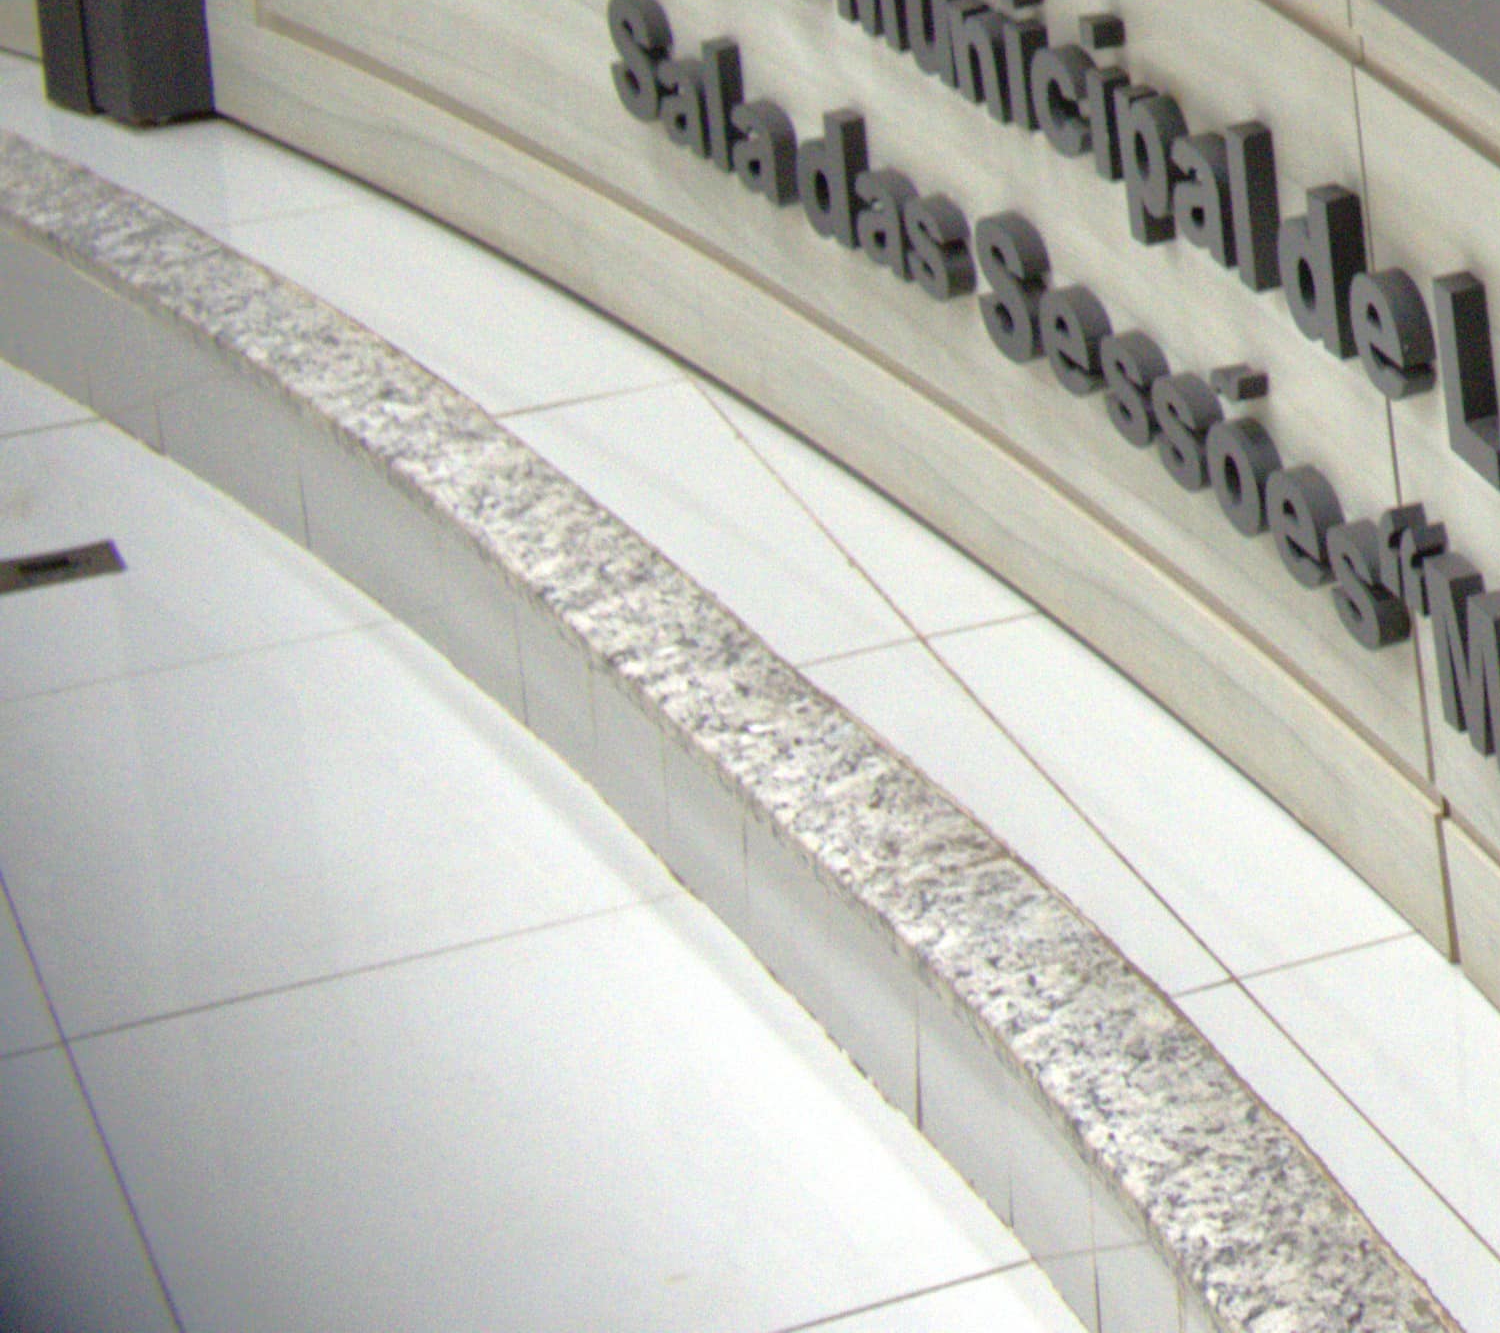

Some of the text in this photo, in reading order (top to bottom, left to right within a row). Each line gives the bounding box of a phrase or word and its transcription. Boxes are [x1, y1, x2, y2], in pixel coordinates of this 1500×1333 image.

[797, 108, 976, 301] das
[975, 211, 1412, 649] Sessões
[1278, 183, 1437, 401] de
